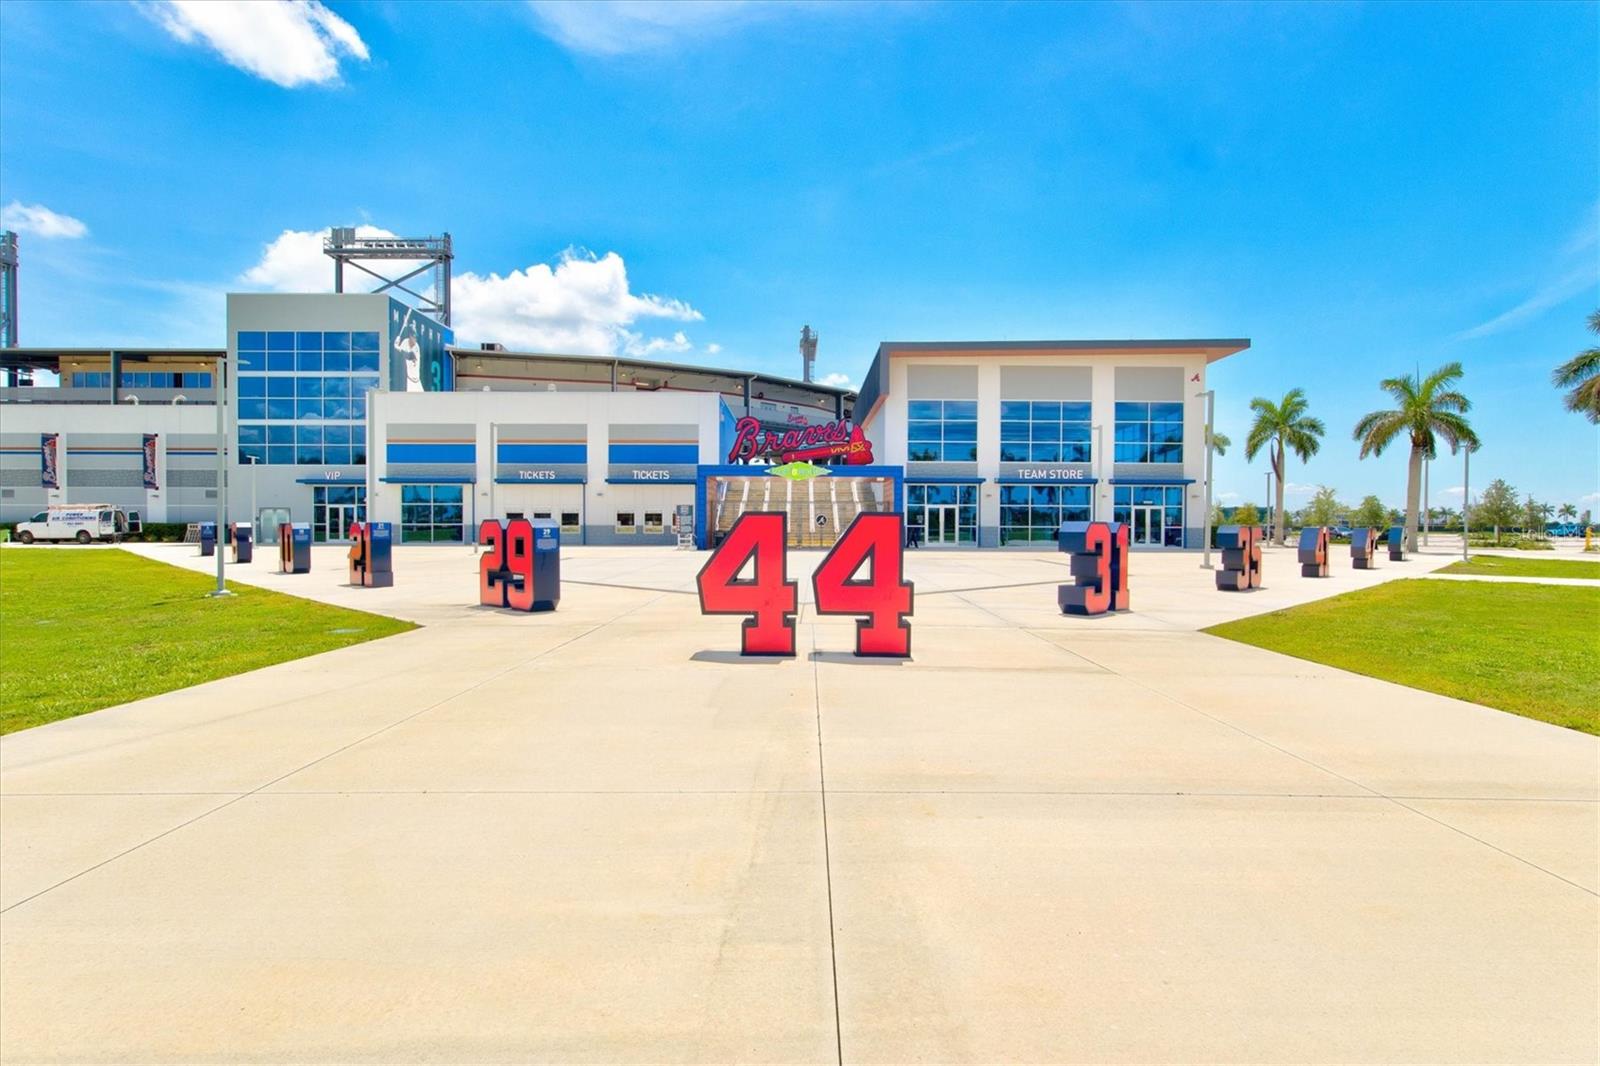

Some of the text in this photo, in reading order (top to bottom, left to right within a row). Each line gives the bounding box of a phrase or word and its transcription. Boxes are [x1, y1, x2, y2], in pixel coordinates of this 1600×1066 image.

[728, 415, 848, 464] Braves
[325, 471, 341, 480] VIP
[519, 470, 556, 480] TICKETS
[632, 470, 670, 480] TICKETS
[1018, 469, 1084, 479] TEAM STORE
[480, 519, 534, 611] 29
[1085, 522, 1129, 614] 31
